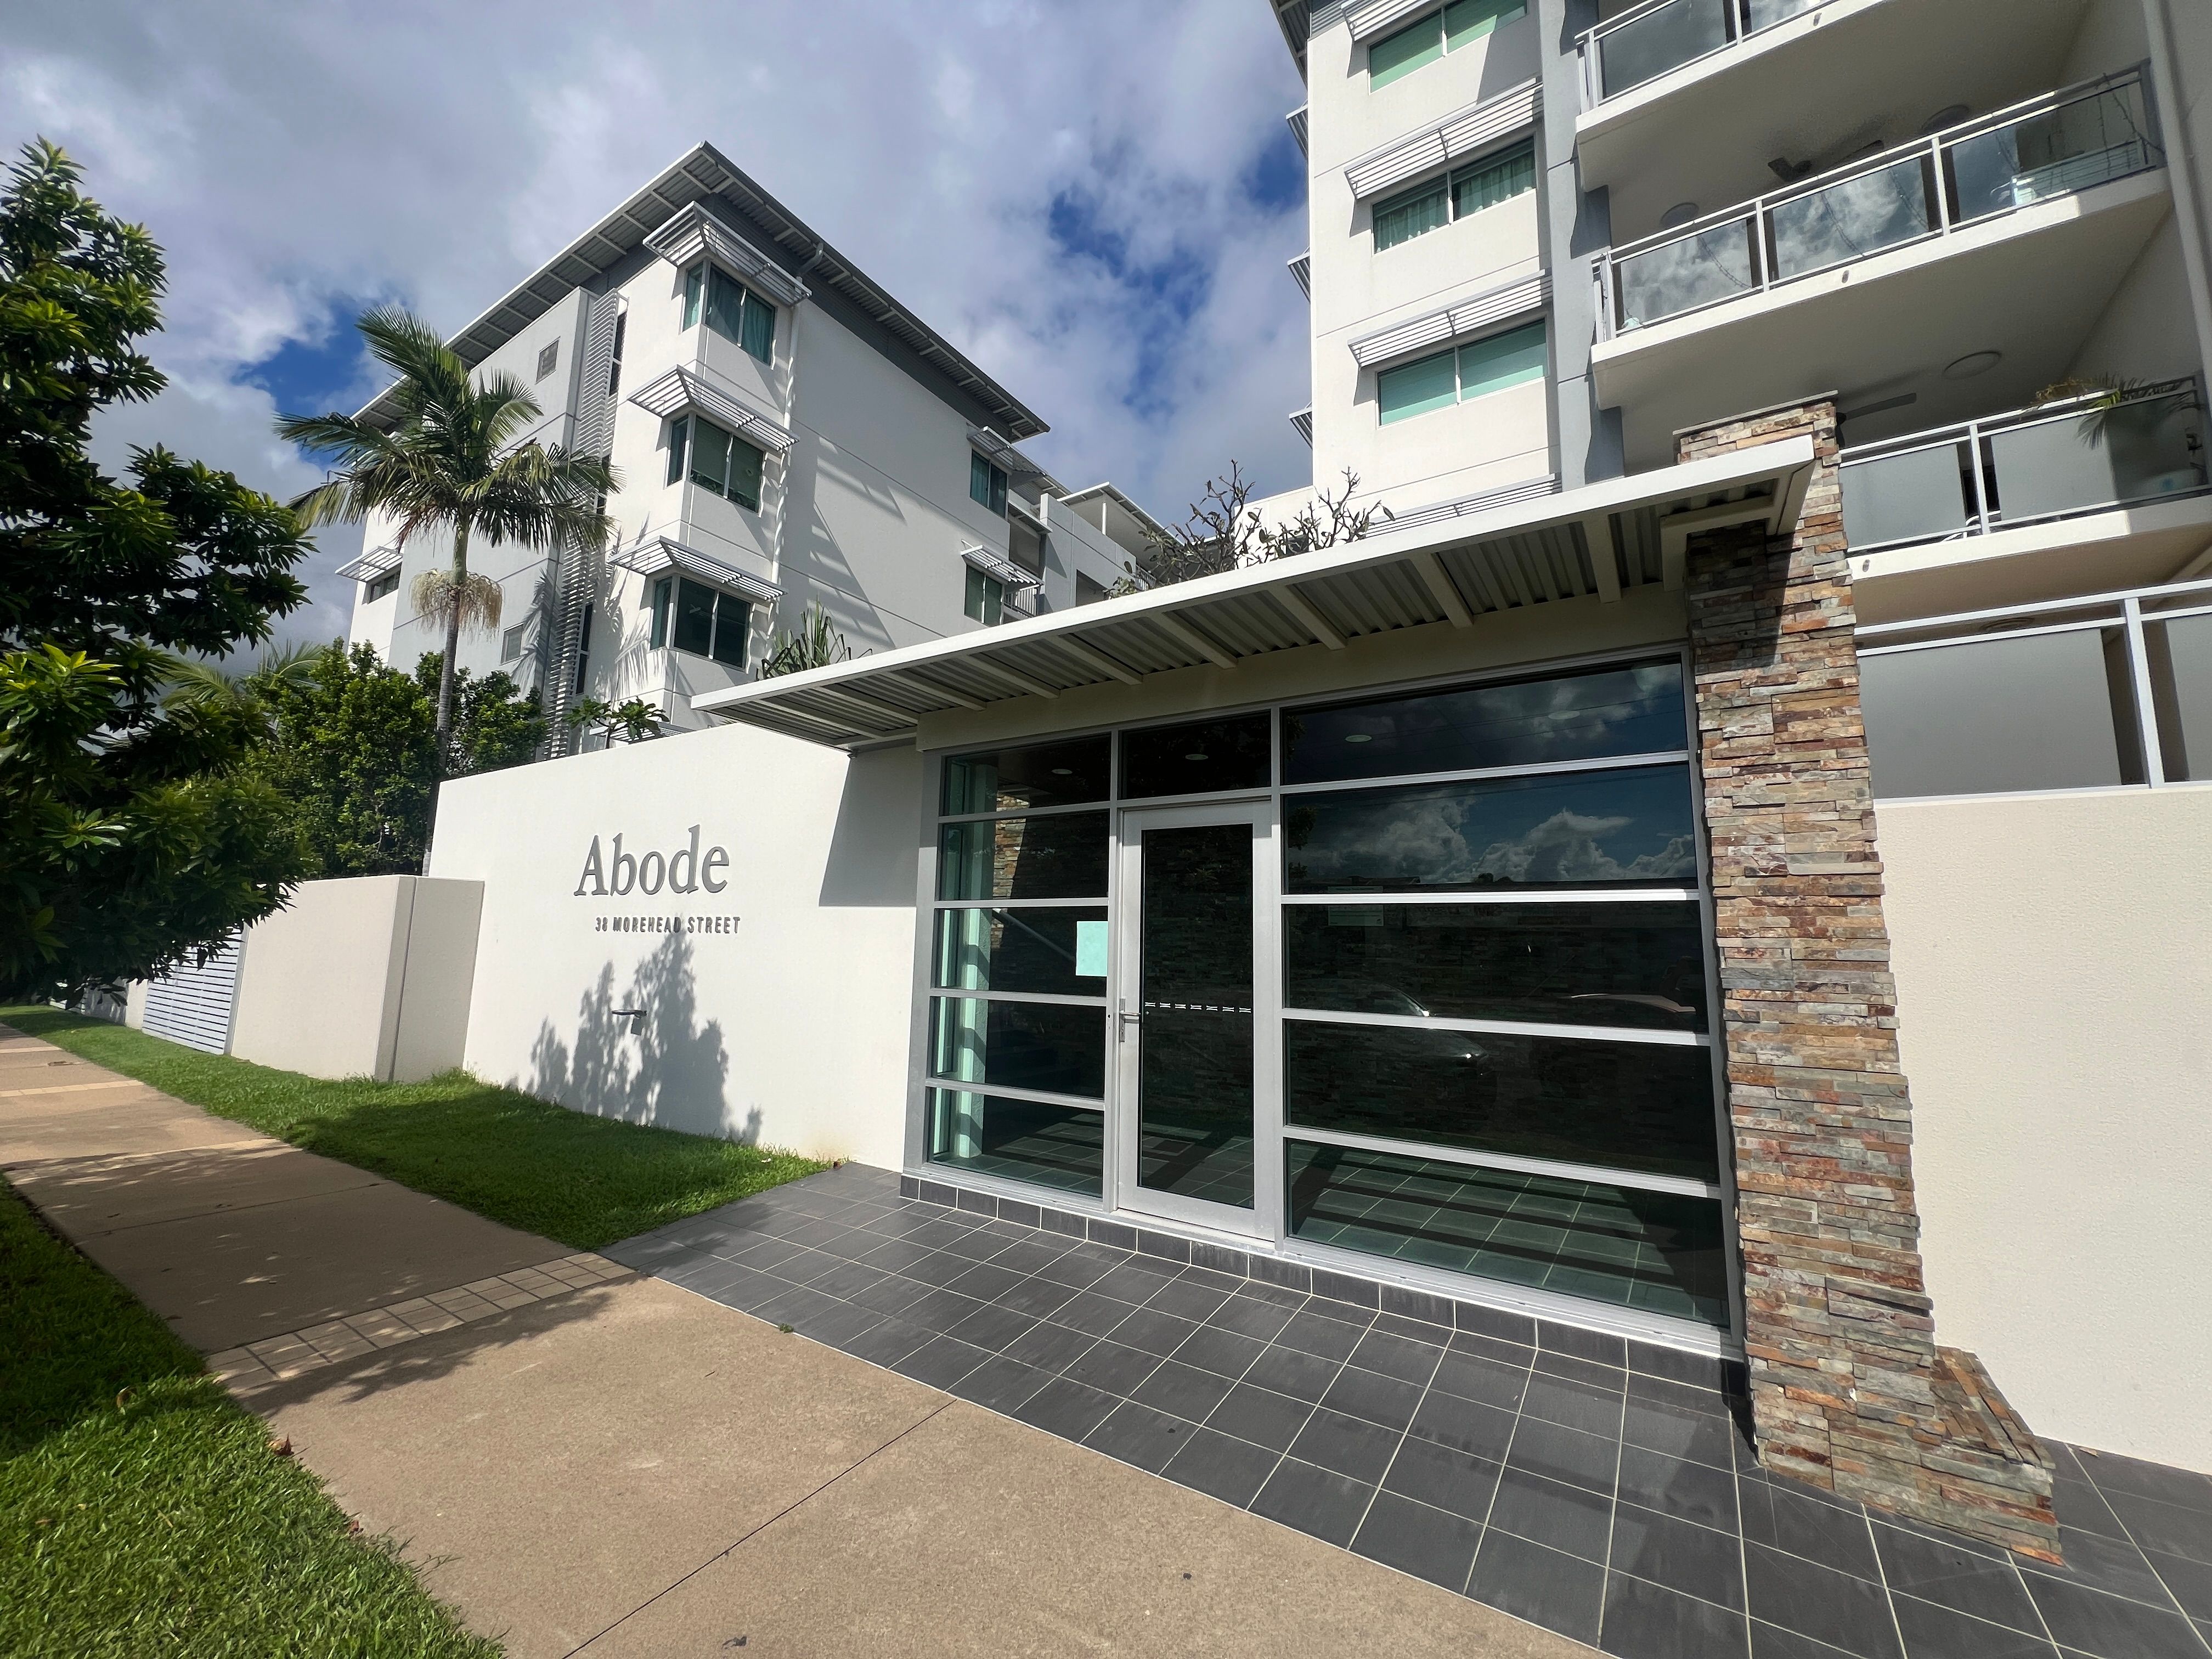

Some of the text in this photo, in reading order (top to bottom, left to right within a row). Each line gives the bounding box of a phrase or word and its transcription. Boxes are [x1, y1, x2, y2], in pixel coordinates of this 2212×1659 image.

[573, 824, 730, 896] Abode
[595, 916, 741, 934] 38 MOREHEAD STREET
